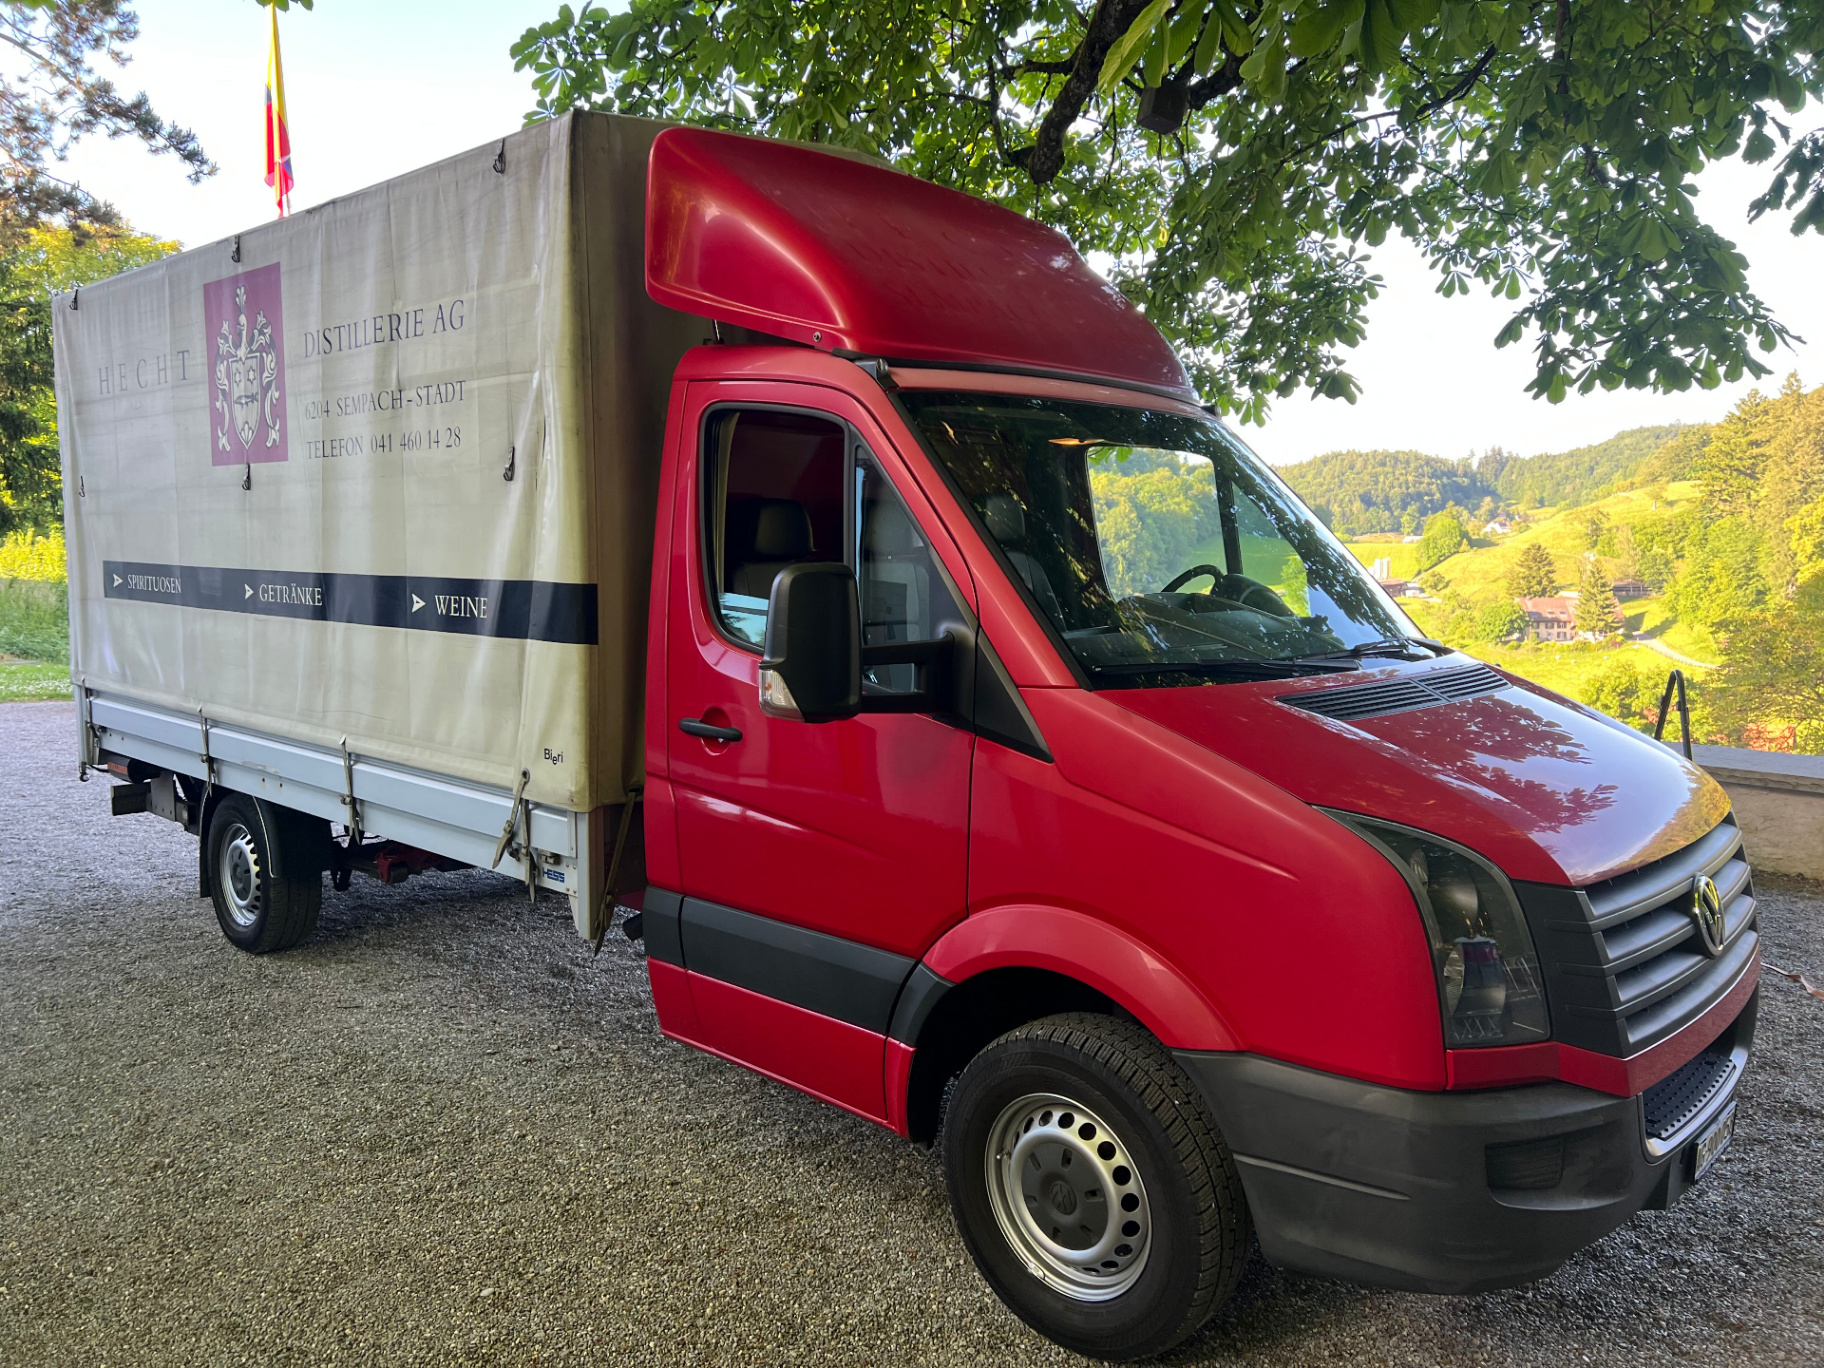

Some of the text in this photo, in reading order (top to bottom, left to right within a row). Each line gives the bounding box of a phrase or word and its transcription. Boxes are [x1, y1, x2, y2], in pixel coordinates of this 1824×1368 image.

[303, 299, 465, 359] DISTILLERIE AG
[98, 349, 190, 395] HECHT
[305, 380, 466, 420] 6204 SEMPACH-STADT
[306, 426, 462, 460] TELEFON 041 460 14 28
[127, 574, 182, 594] SPIRITUOSEN
[259, 583, 323, 606] GETRÄNKE
[434, 594, 489, 619] WEINE
[543, 747, 564, 766] Bieri
[541, 866, 565, 883] HESS
